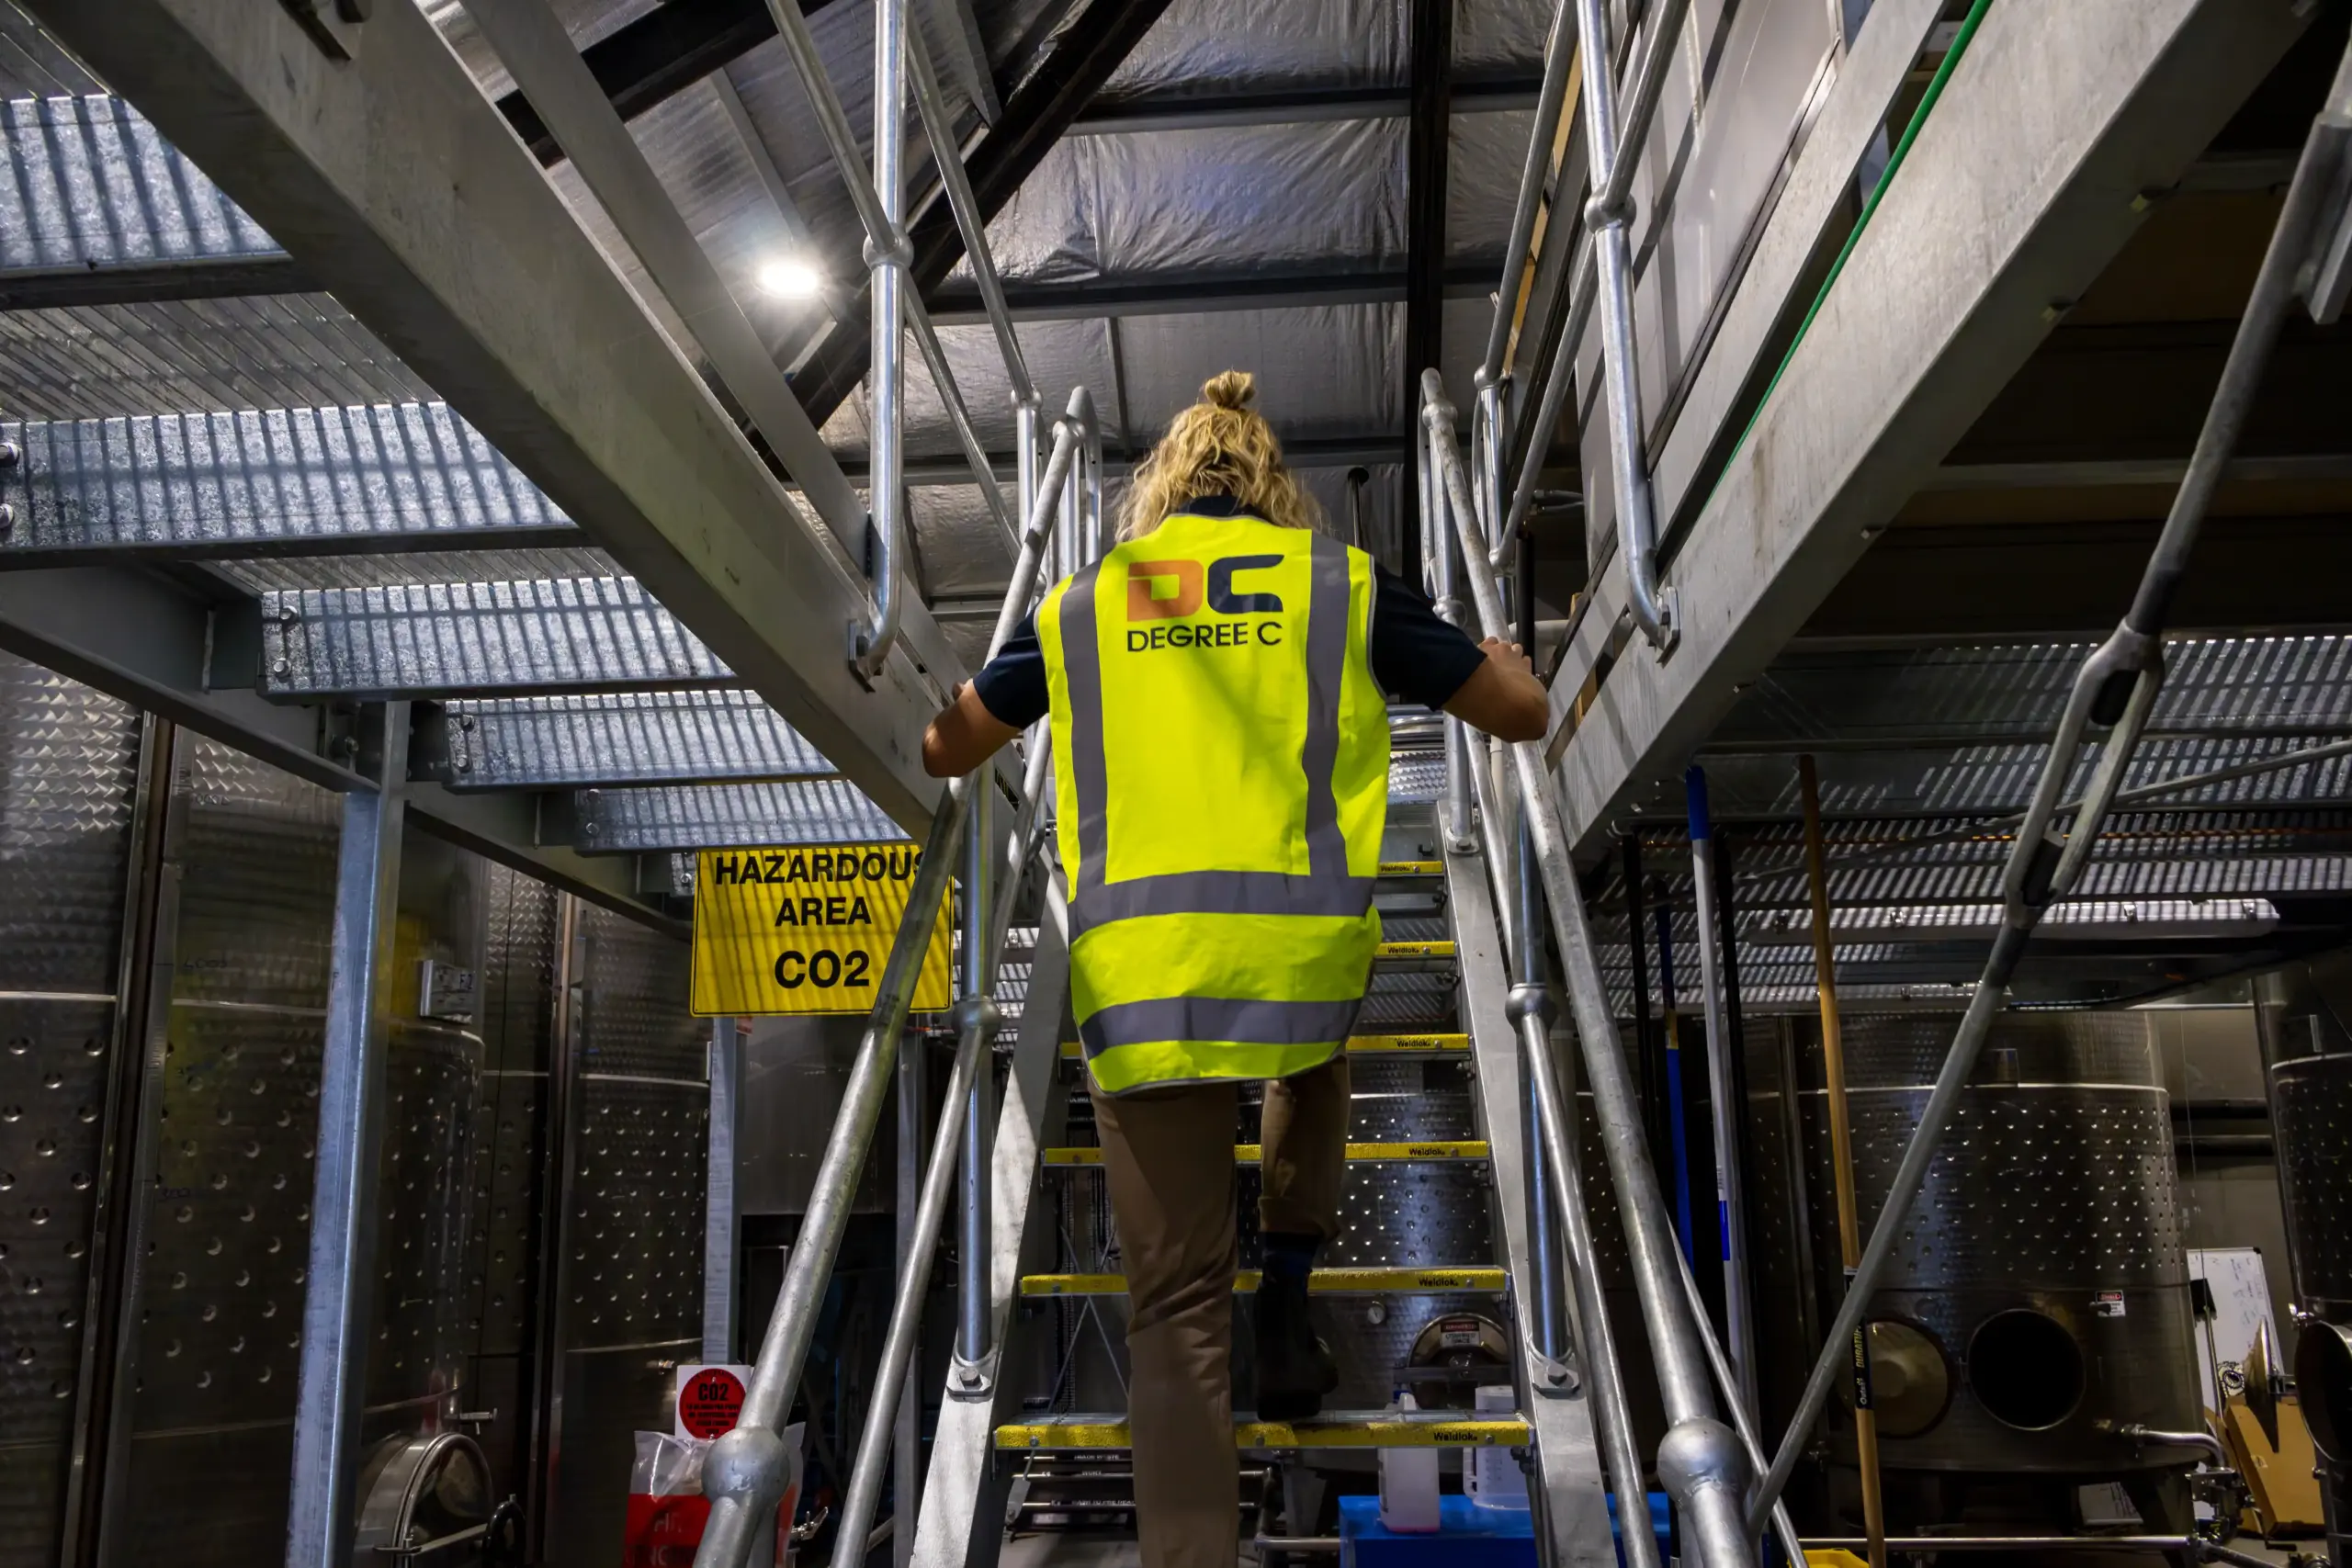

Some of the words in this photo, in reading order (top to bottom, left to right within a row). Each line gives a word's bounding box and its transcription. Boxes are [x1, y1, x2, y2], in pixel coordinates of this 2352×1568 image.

[1126, 554, 1284, 622] DC
[1126, 622, 1249, 652] DEGREE
[1257, 621, 1283, 646] C
[775, 896, 873, 927] AREA
[774, 949, 870, 989] CO2
[1418, 1278, 1454, 1286] Weldlok
[698, 1382, 729, 1401] CO2
[1432, 1432, 1474, 1441] Weldlok
